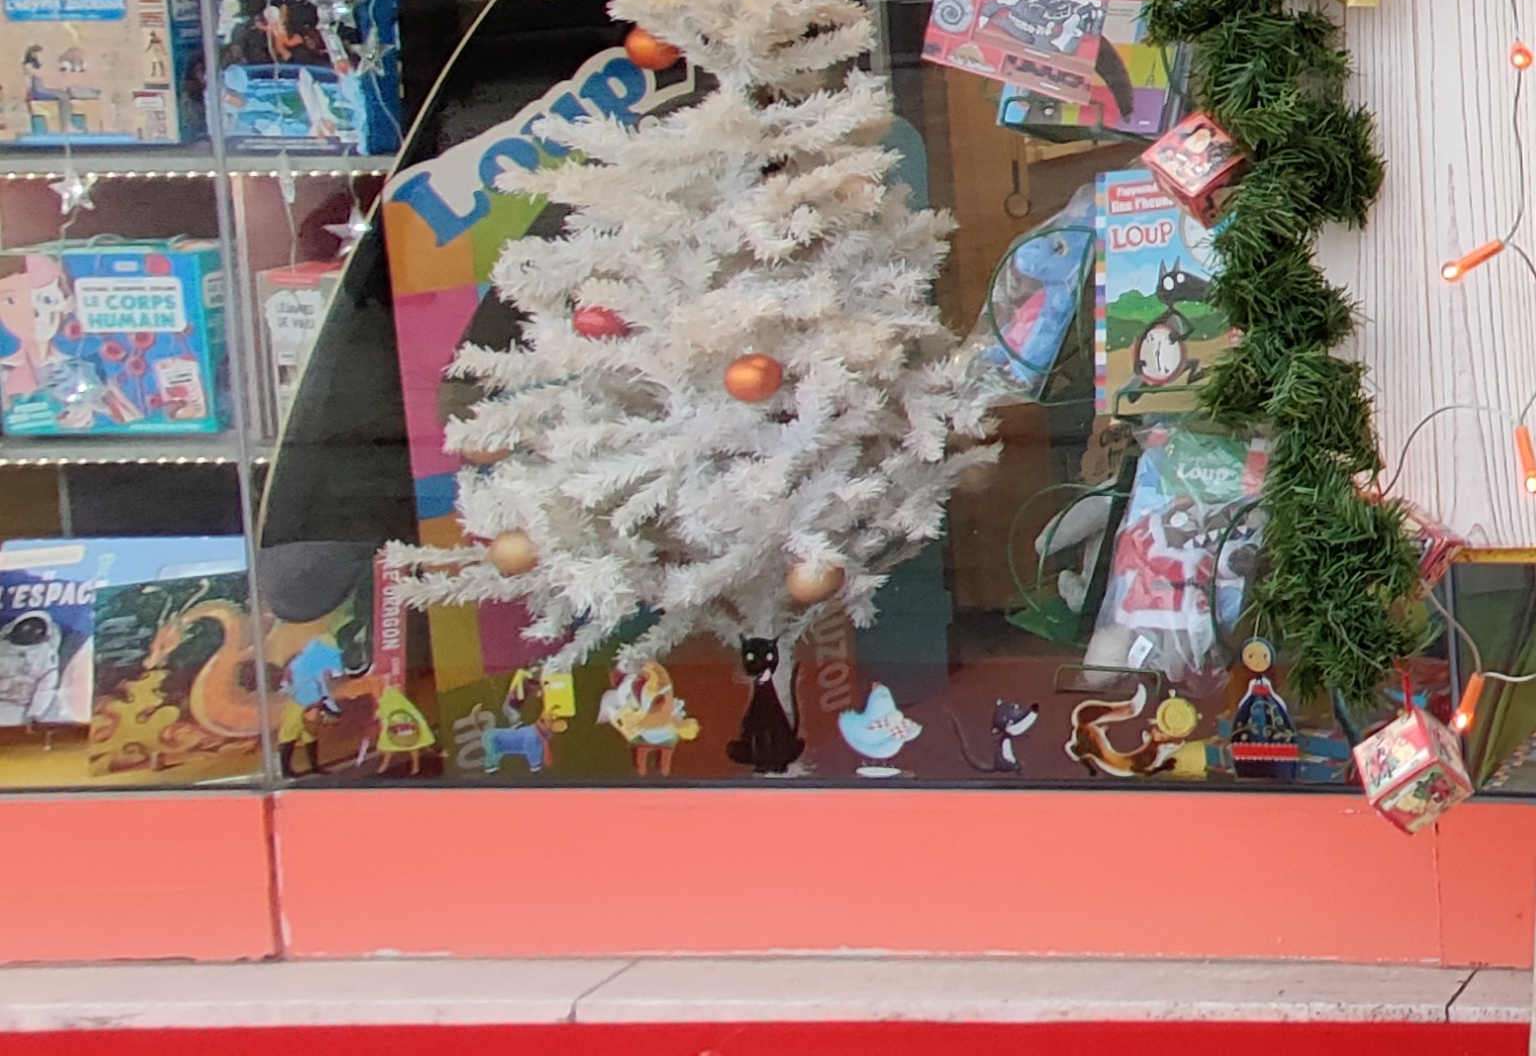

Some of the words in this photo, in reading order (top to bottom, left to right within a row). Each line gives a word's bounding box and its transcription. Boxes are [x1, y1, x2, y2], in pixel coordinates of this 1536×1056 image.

[1111, 221, 1173, 250] LOUP
[83, 296, 100, 309] LE
[104, 294, 177, 310] CORPS
[87, 312, 176, 329] HUMAIN
[1177, 461, 1229, 484] Loup
